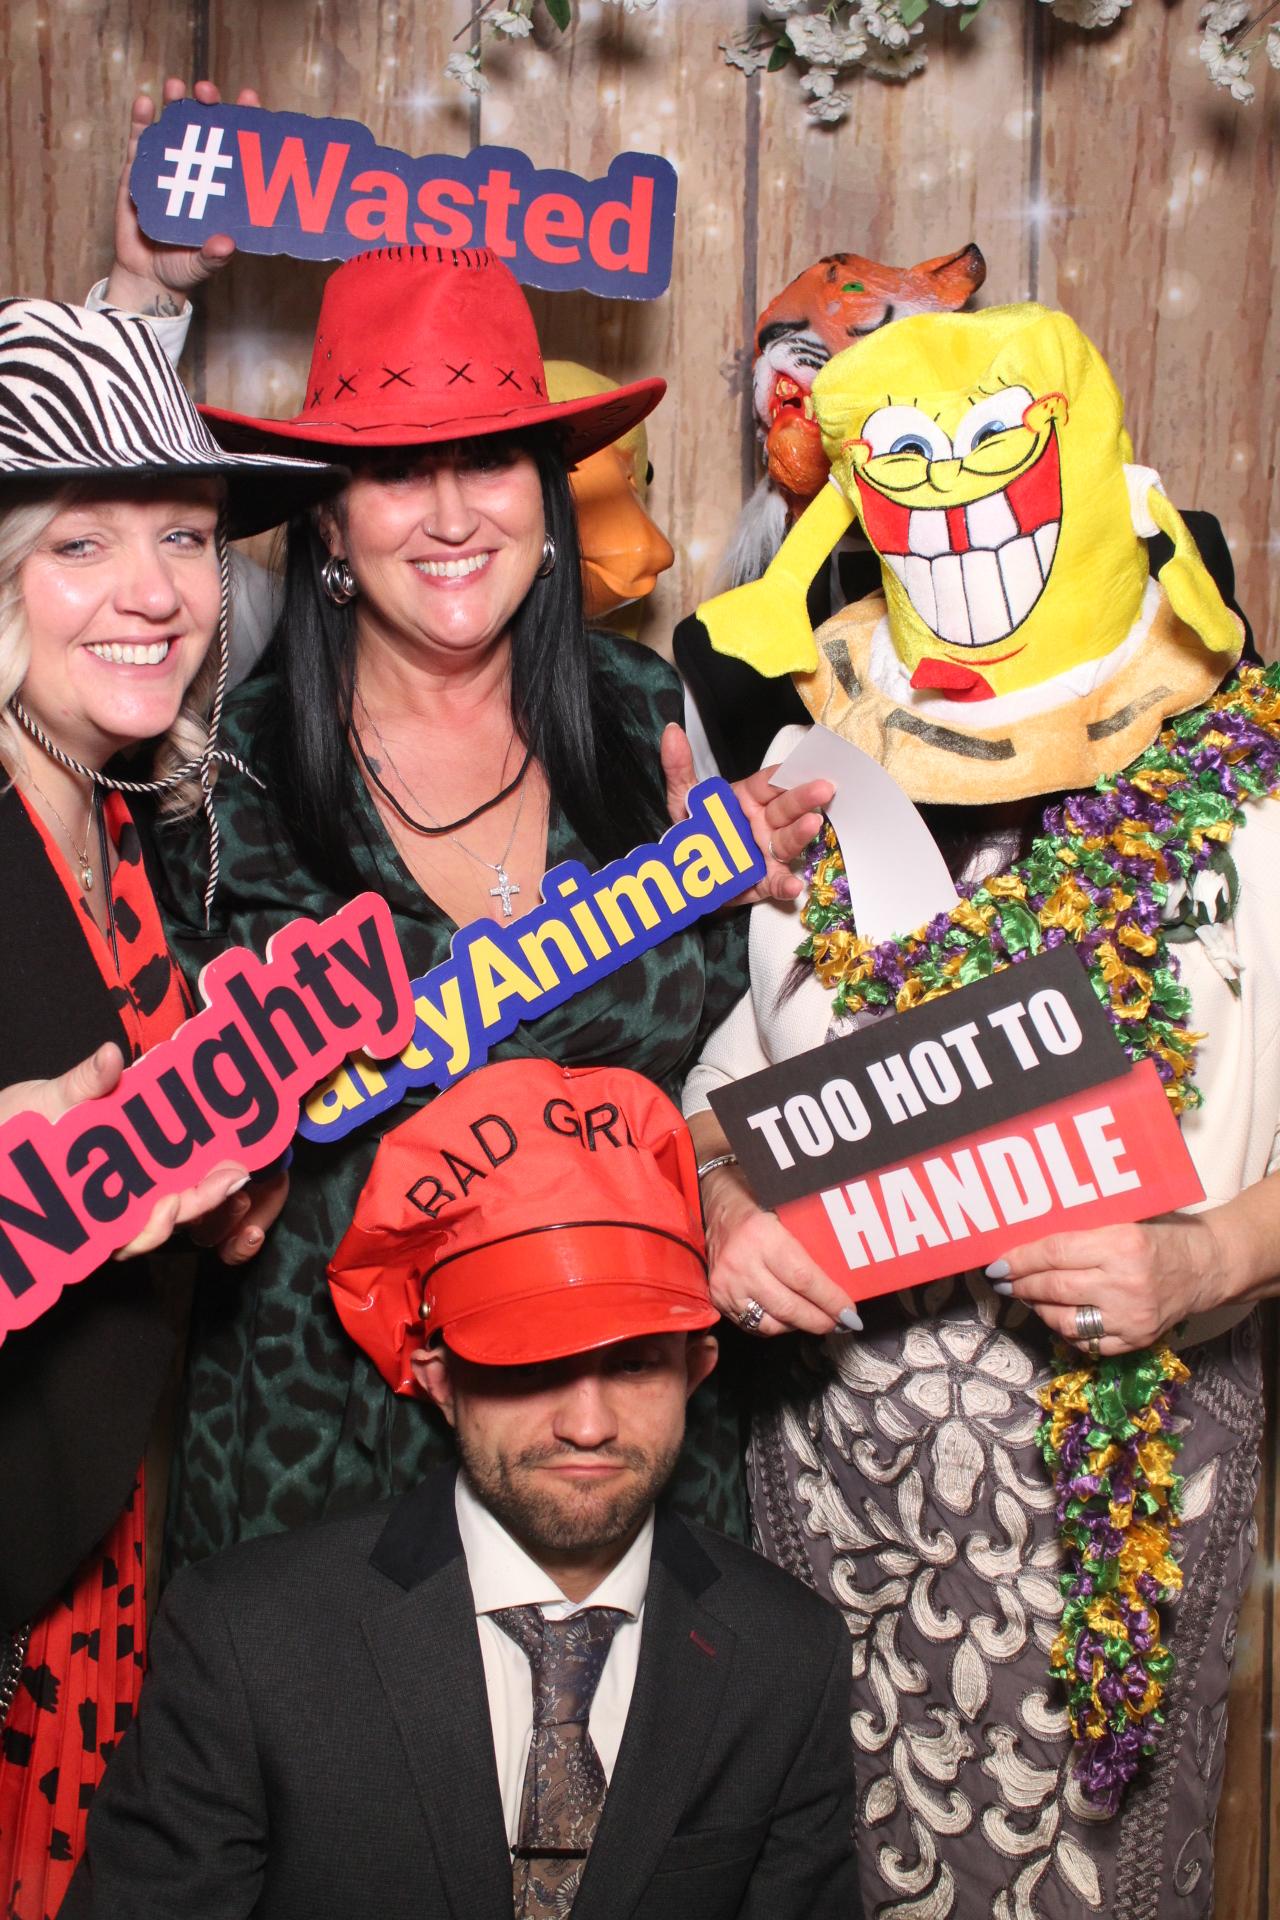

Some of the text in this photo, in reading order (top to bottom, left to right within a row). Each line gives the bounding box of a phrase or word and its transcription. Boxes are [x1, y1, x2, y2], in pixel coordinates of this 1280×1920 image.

[157, 124, 655, 274] #Wasted
[747, 988, 1083, 1170] TOO HOT TO
[404, 1113, 518, 1220] BAD
[820, 1106, 1141, 1270] HANDLE
